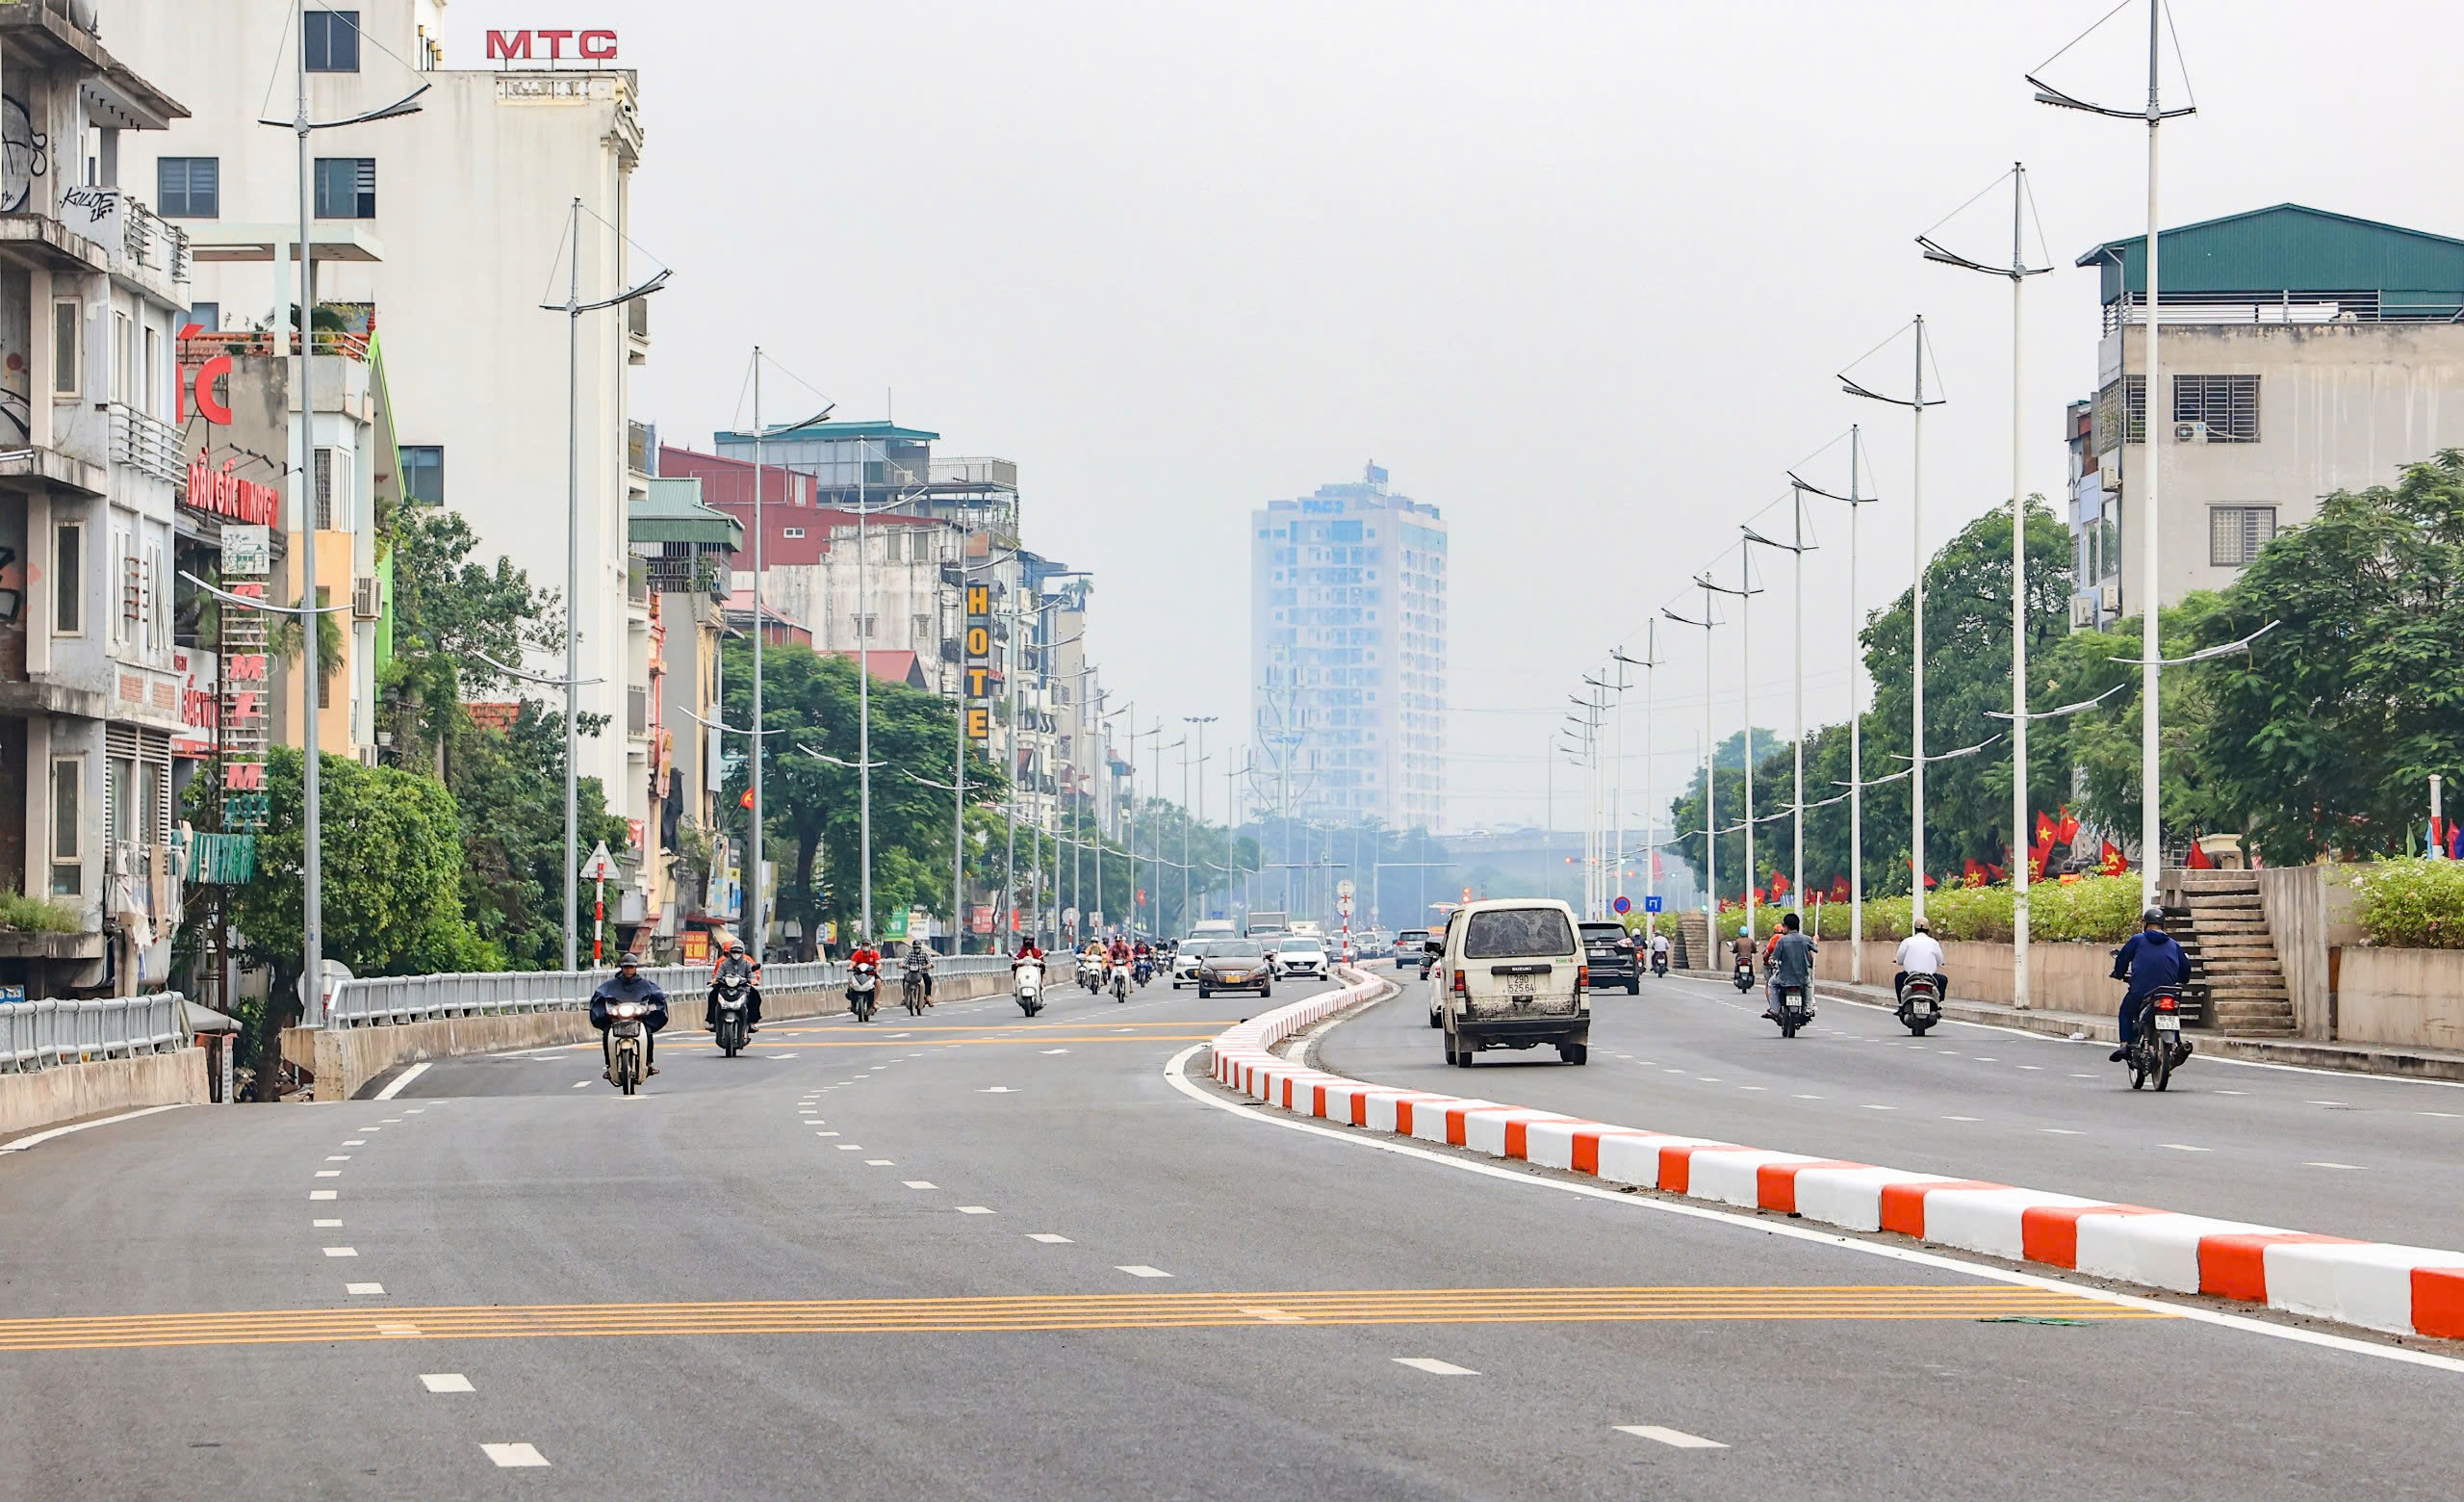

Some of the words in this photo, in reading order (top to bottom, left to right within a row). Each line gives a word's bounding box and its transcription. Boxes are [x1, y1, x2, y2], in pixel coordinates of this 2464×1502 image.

[486, 30, 617, 59] MTC
[968, 586, 988, 738] HOTE
[1509, 984, 1534, 993] 525.64
[1514, 974, 1529, 984] 29D
